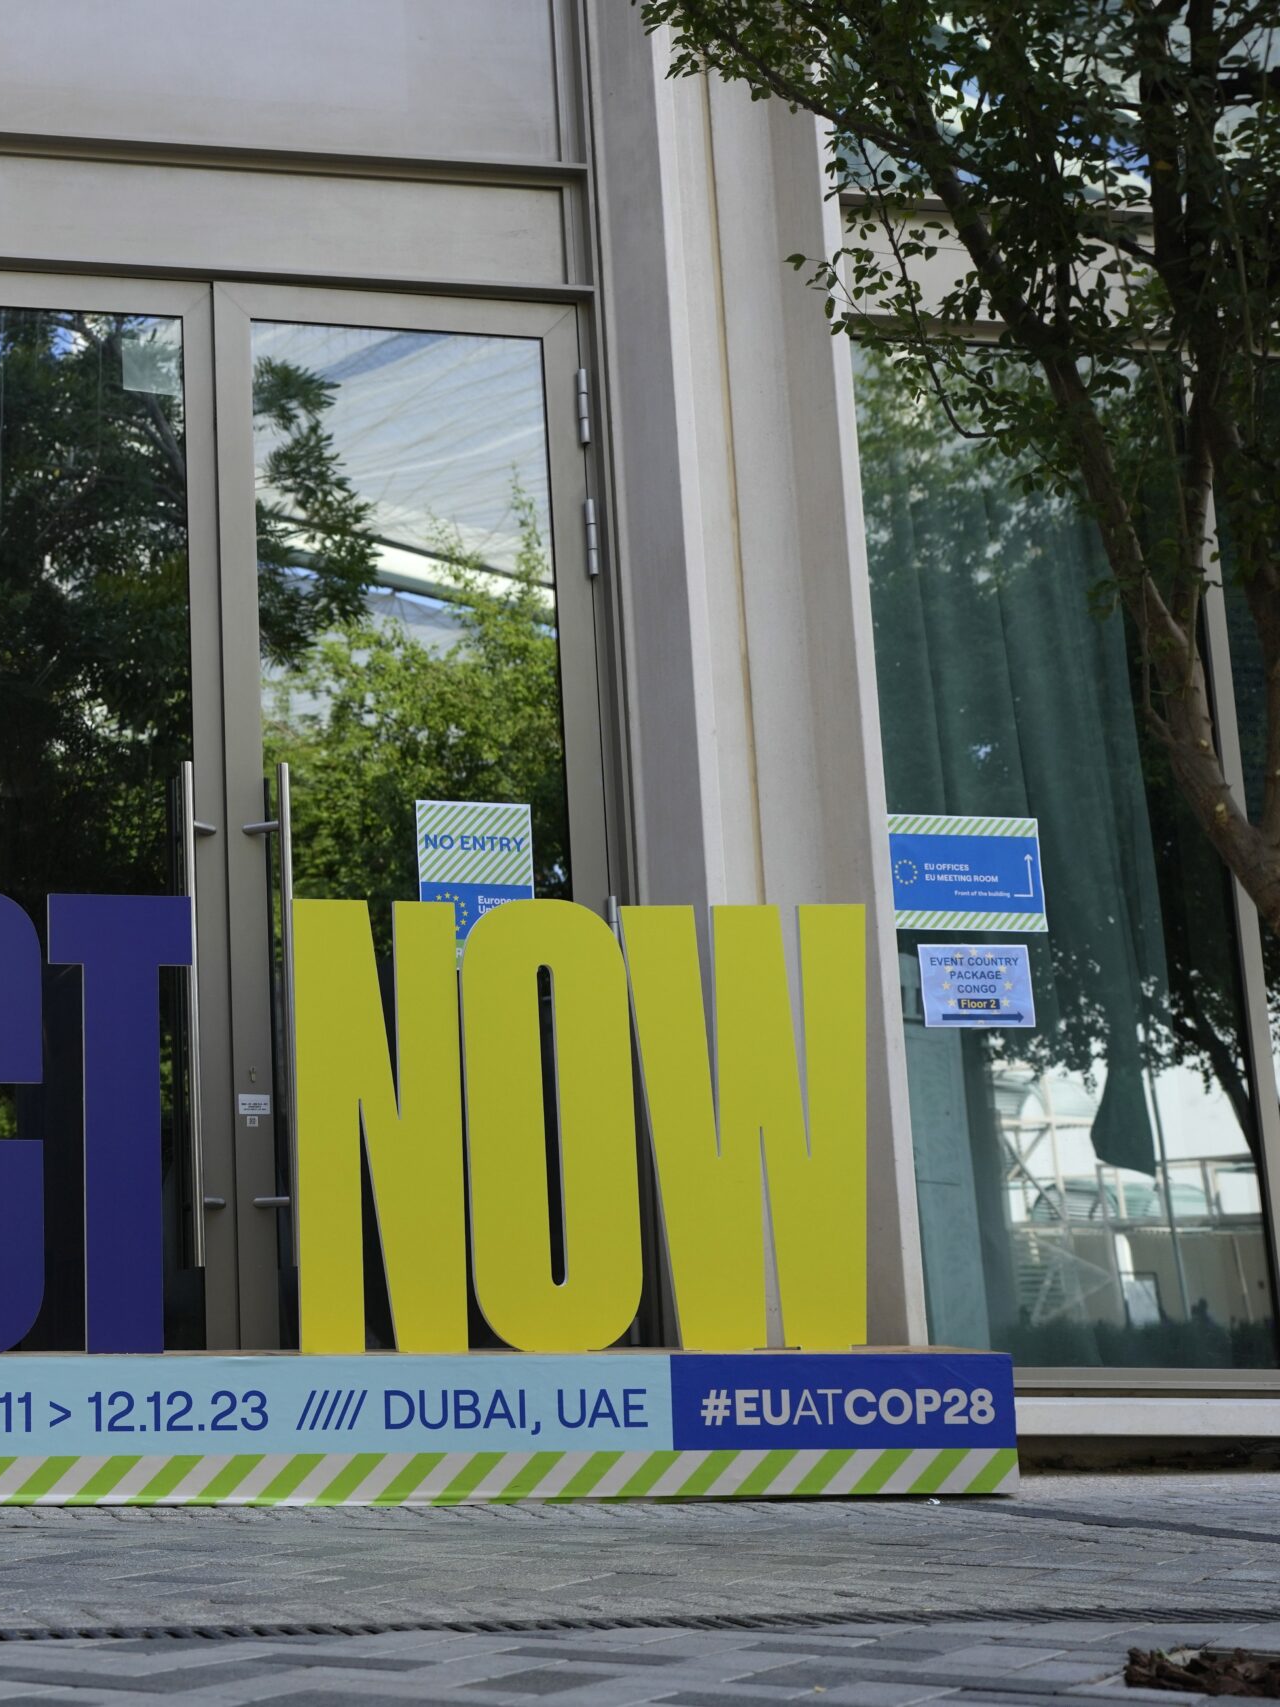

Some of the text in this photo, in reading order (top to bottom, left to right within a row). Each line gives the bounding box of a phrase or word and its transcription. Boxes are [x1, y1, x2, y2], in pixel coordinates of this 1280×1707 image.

[424, 834, 524, 852] NO ENTRY
[924, 863, 970, 871] EU OFFICES
[925, 873, 999, 883] EU MEETING ROOM
[988, 890, 1011, 898] building
[930, 957, 1019, 967] EVENT COUNTRY
[949, 970, 1002, 980] PACKAGE
[957, 984, 997, 994] CONGO
[961, 999, 997, 1009] Floor 2
[291, 898, 867, 1353] NOW
[700, 1387, 996, 1426] #EUATCOP28
[87, 1390, 269, 1432] 12.12.23
[383, 1389, 542, 1436] DUBAI,
[557, 1388, 649, 1429] UAE
